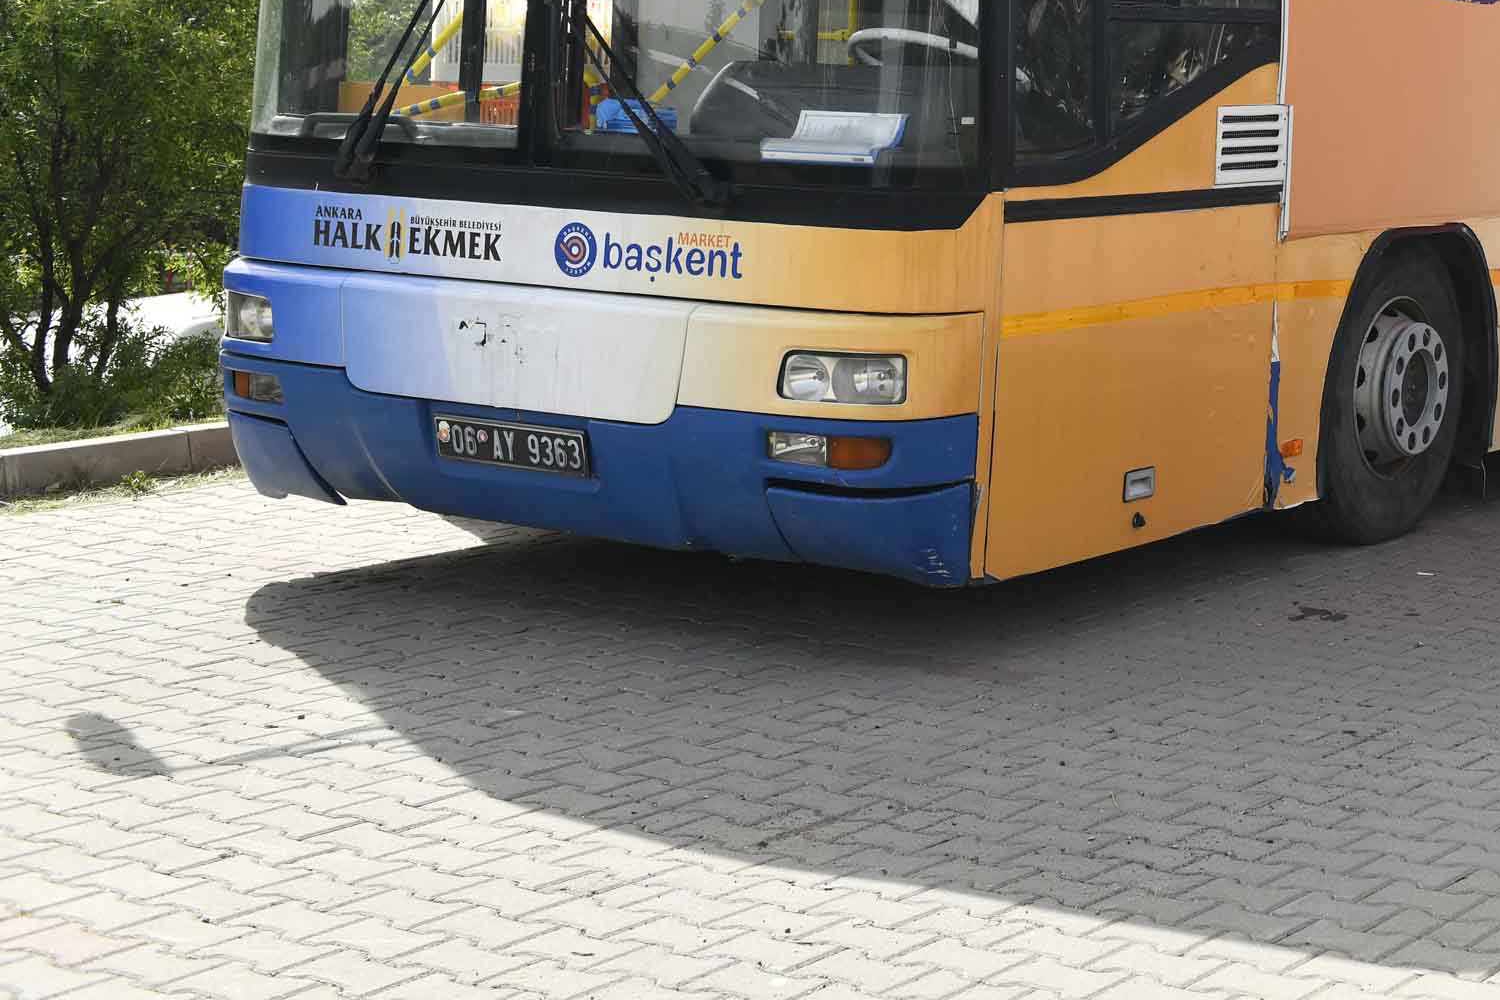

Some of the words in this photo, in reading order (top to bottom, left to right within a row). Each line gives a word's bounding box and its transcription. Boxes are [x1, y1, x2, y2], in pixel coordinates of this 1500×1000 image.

[315, 205, 362, 220] ANKARA
[410, 216, 457, 228] BÜYÜKŞEHİR
[459, 219, 501, 231] BELEDİYESİ
[313, 219, 382, 252] HALK
[408, 226, 502, 262] EKMEK
[678, 231, 732, 249] MARKET
[603, 232, 742, 283] başkent
[451, 424, 478, 456] 06
[493, 428, 515, 462] AY
[527, 433, 582, 470] 9363
